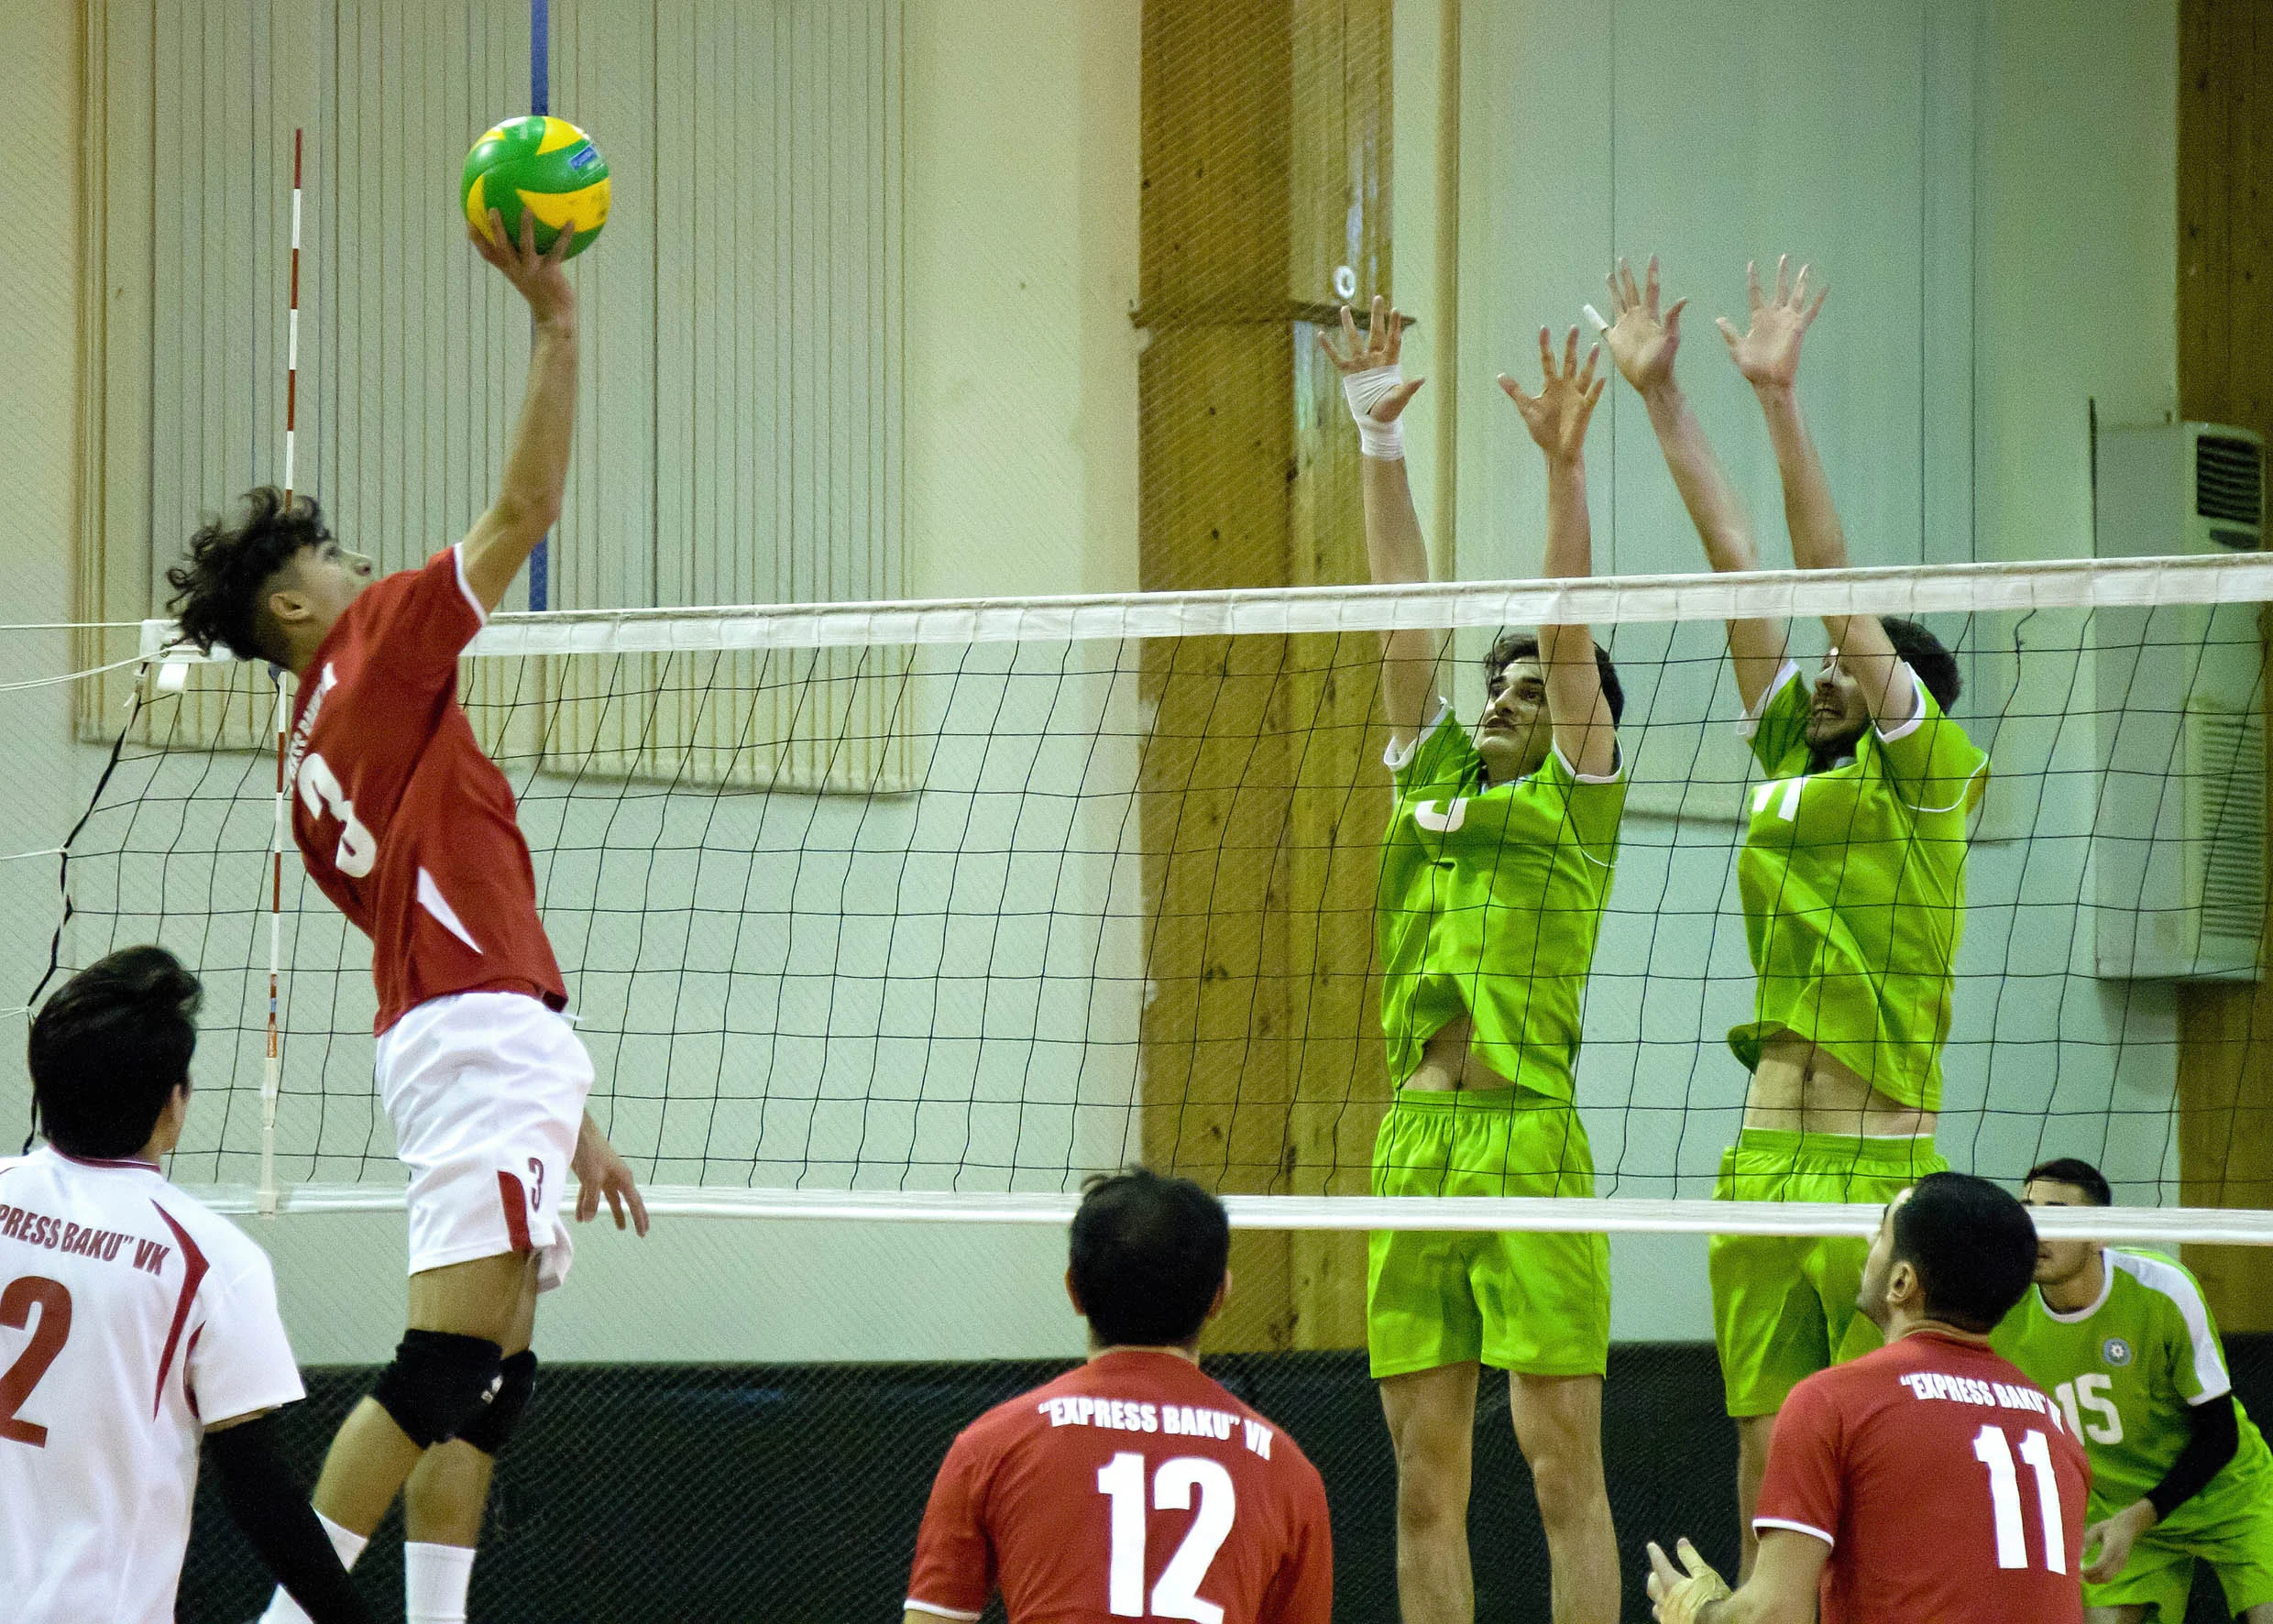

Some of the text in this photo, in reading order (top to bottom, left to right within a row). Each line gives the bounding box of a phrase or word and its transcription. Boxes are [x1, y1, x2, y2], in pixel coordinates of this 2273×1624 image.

[297, 752, 377, 878] 3
[528, 1158, 544, 1213] 3
[133, 1239, 170, 1276] VK
[0, 1276, 72, 1448] 2
[2055, 1374, 2124, 1446] 15
[1243, 1420, 1273, 1461] VK
[1097, 1452, 1236, 1624] 12
[1973, 1424, 2067, 1575] 11
